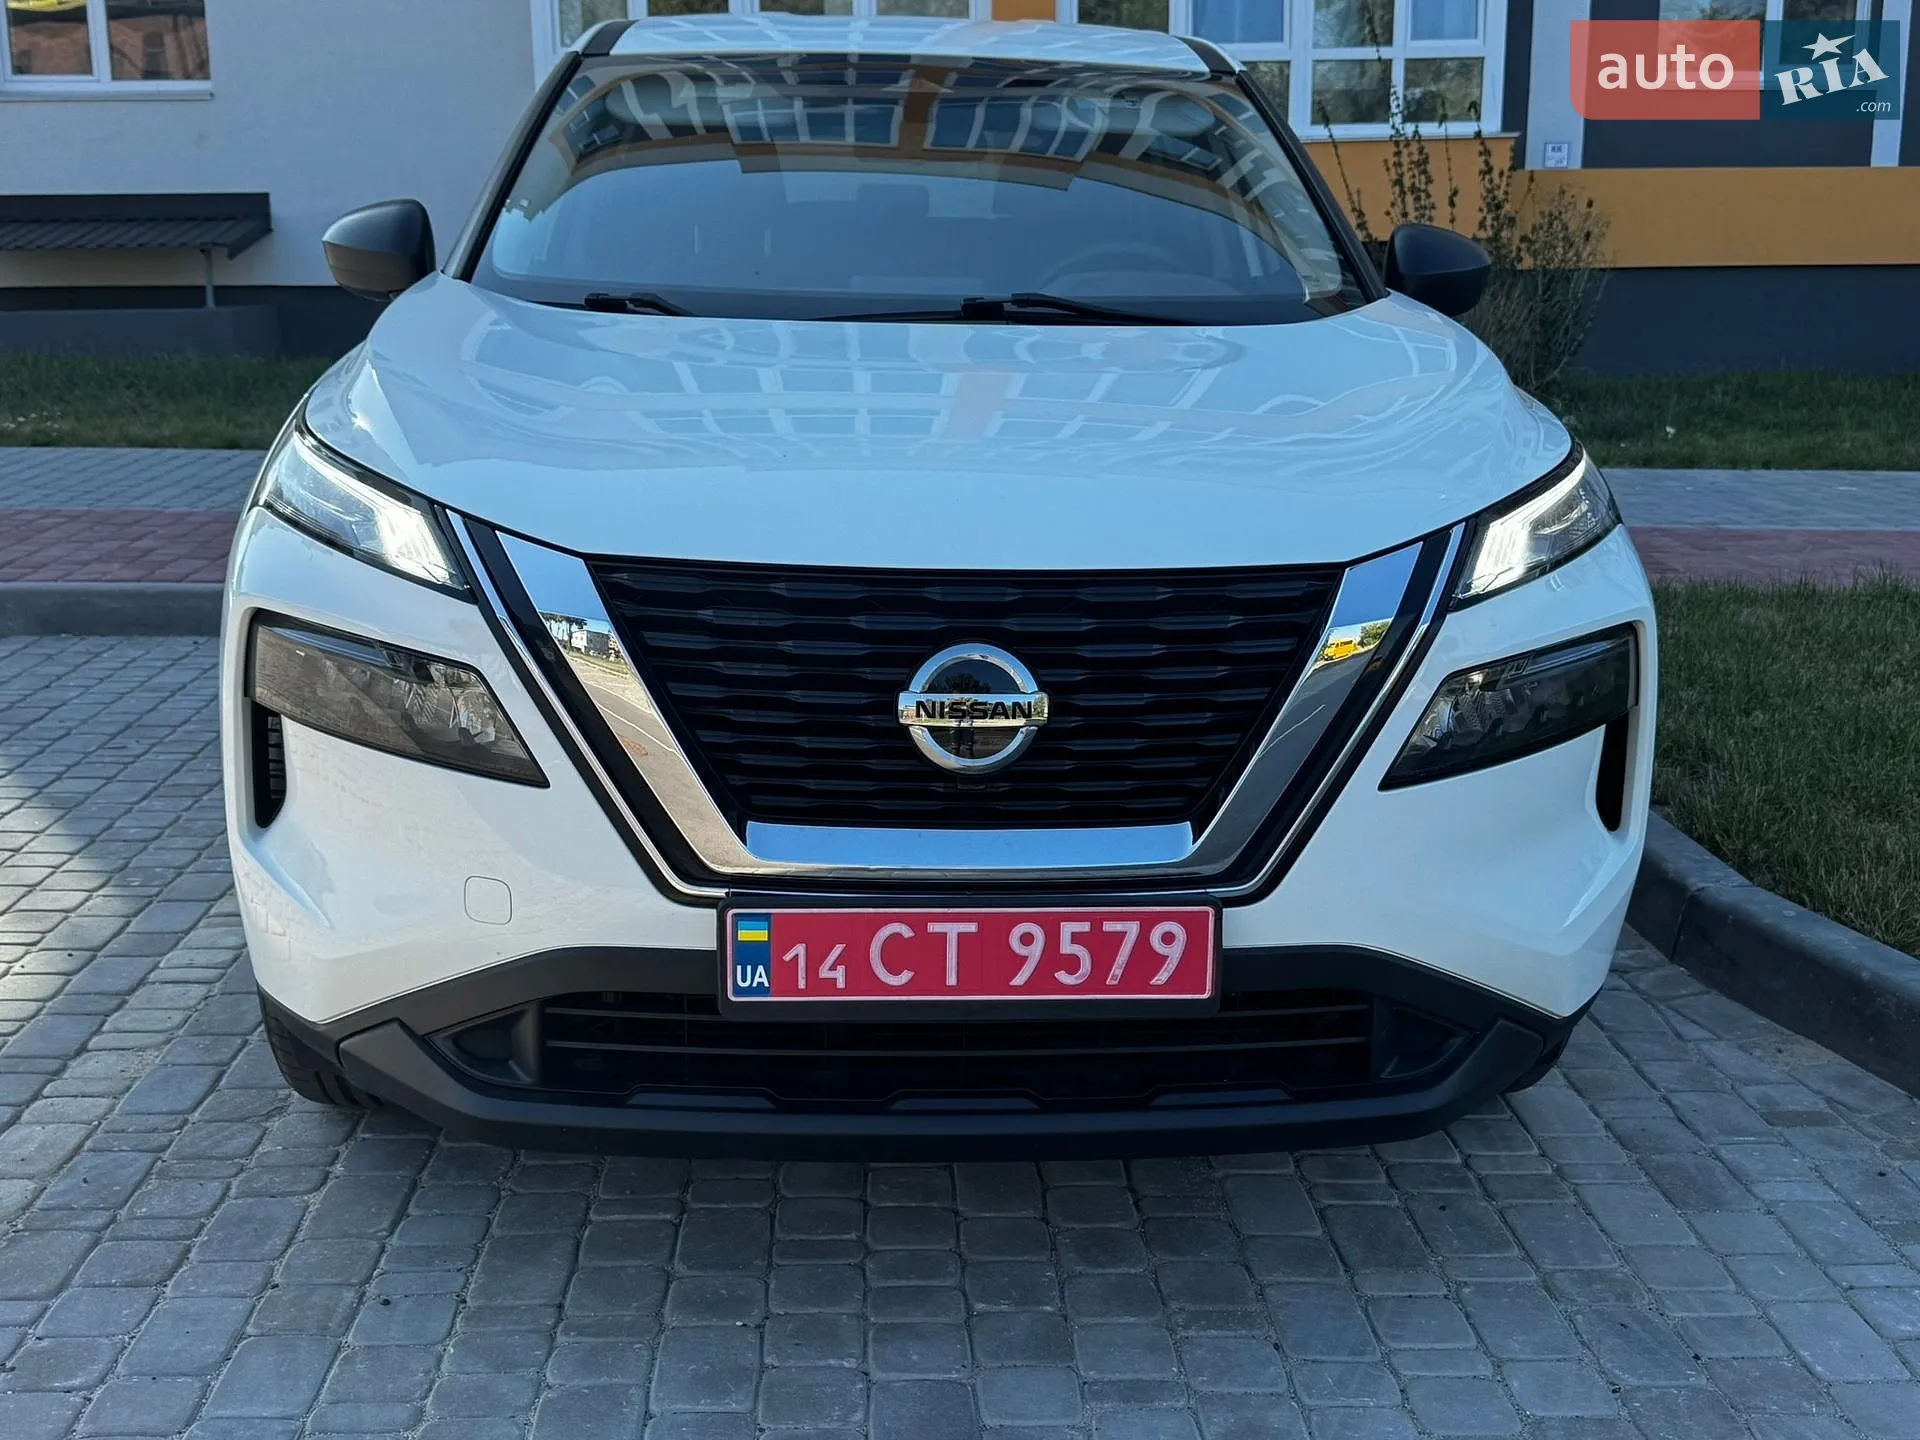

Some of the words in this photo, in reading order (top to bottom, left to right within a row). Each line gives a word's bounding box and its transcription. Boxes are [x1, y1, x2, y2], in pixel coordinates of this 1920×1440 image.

[915, 700, 1033, 720] NISSAN
[782, 943, 846, 989] 14
[869, 922, 978, 987] CT
[1008, 921, 1187, 986] 9579
[736, 965, 770, 987] UA
